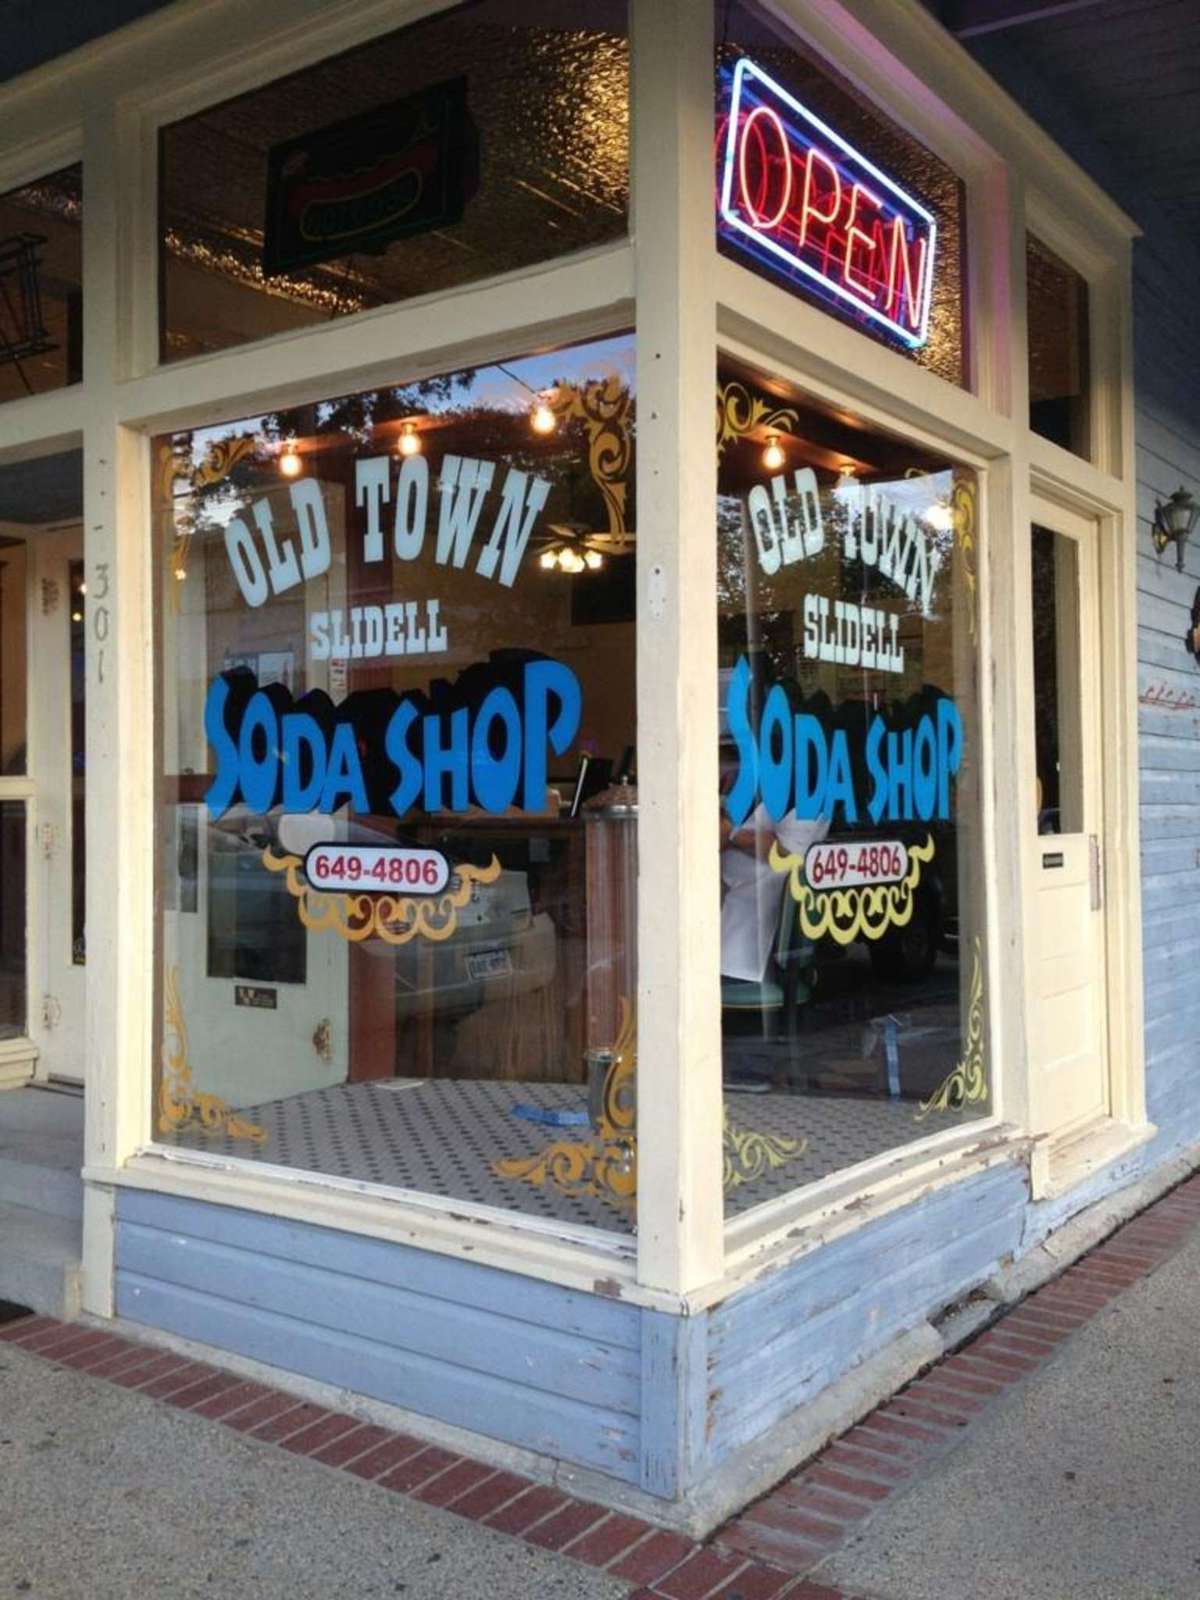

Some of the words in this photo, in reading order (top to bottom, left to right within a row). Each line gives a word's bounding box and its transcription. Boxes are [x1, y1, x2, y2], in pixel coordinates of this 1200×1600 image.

[741, 106, 926, 328] OPEN
[224, 478, 331, 608] OLD
[356, 454, 552, 588] TOWN
[749, 467, 825, 575] OLD
[839, 480, 941, 616] TOWN
[311, 600, 448, 661] SLIDELL
[804, 594, 904, 673] SLIDELL
[204, 675, 370, 821] SODA
[387, 659, 582, 816] SHOP
[724, 655, 858, 828] SODA
[866, 698, 964, 825] SHOP
[315, 855, 439, 885] 649-4806
[813, 845, 900, 883] 649-4806
